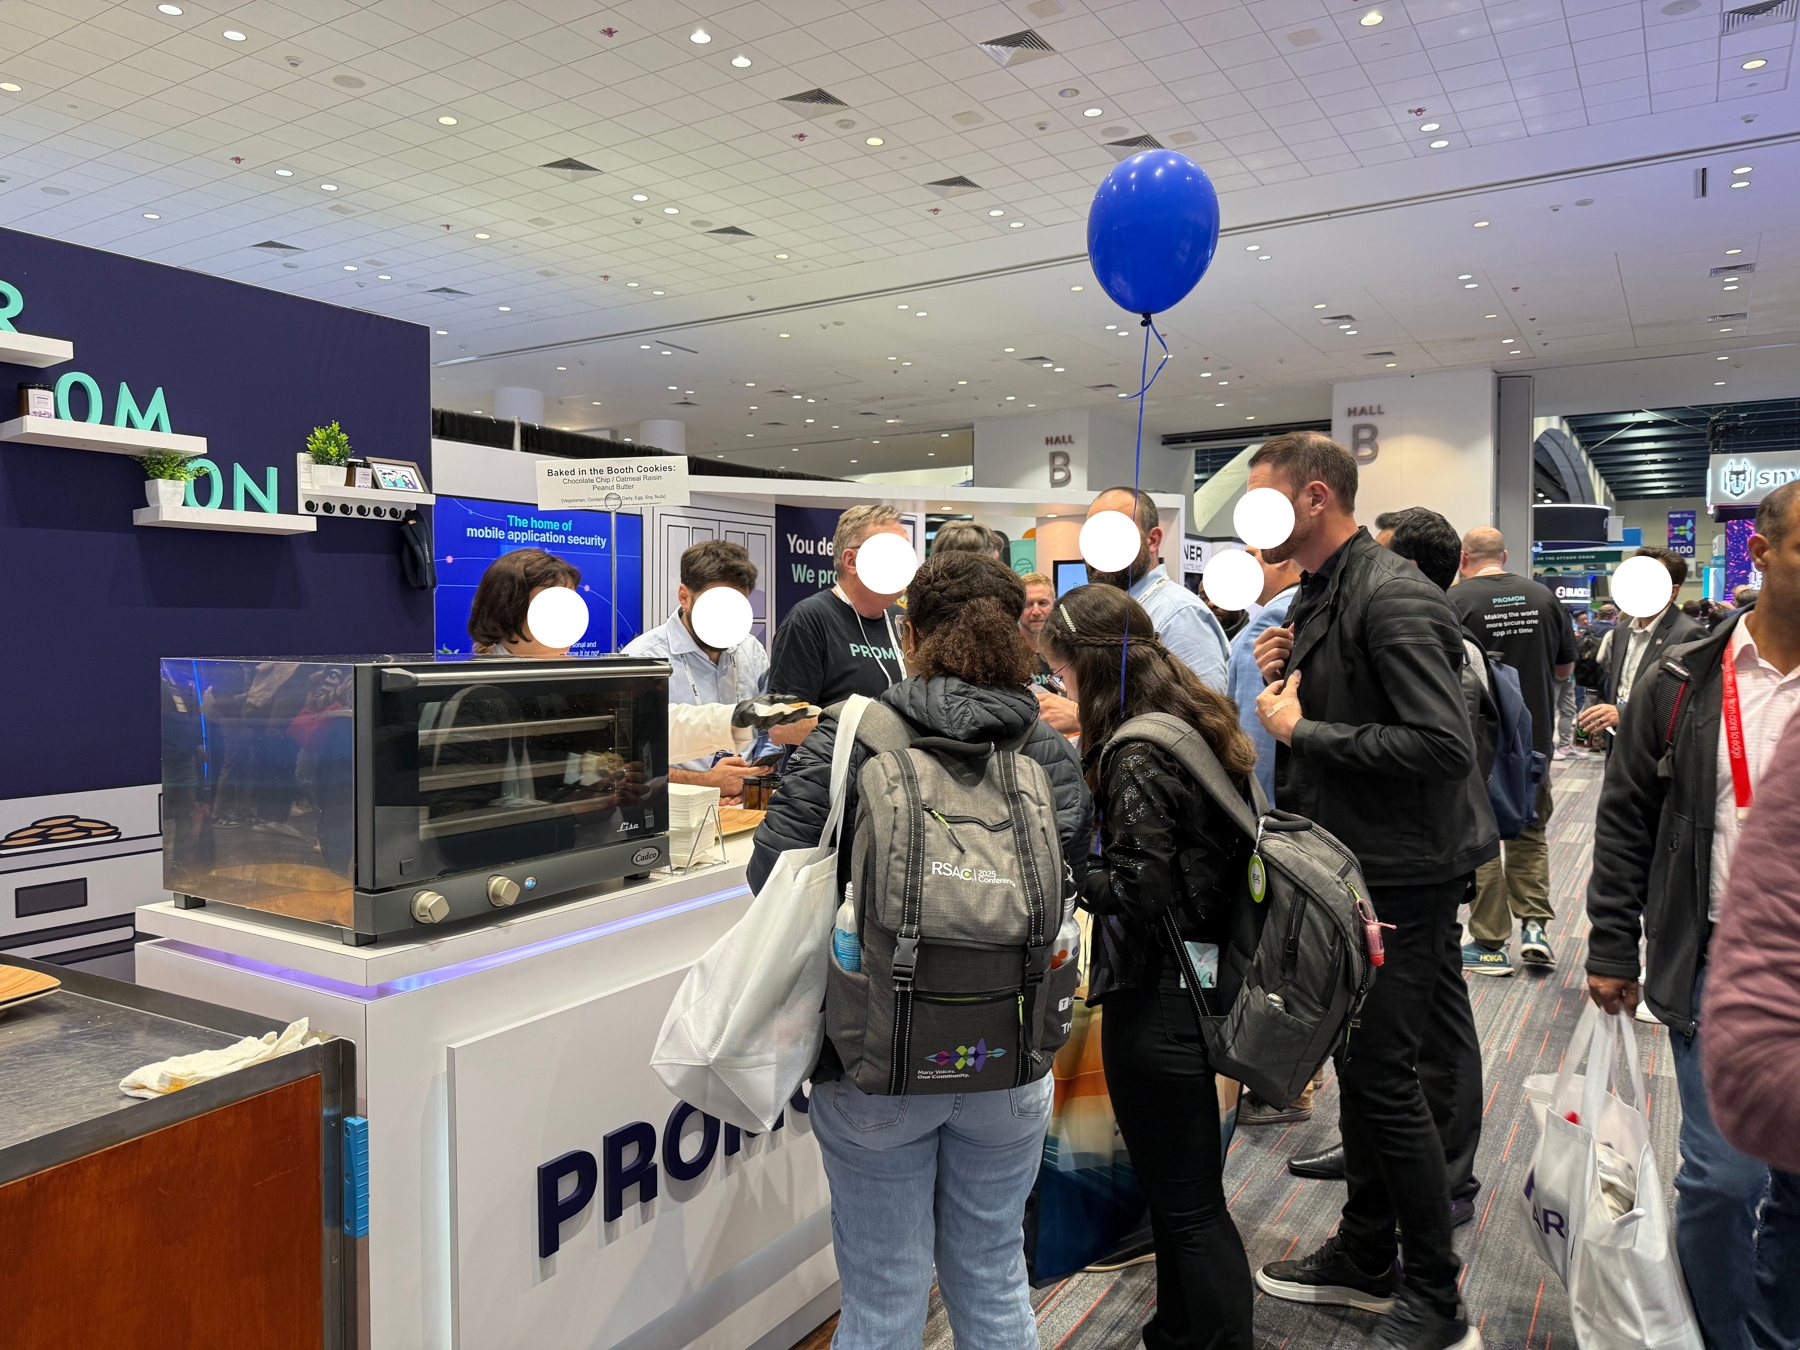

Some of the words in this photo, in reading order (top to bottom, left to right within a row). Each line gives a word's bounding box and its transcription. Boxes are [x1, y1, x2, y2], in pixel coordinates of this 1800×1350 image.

[55, 371, 172, 433] OM
[1347, 404, 1385, 417] HALL
[1045, 434, 1075, 446] HALL
[1352, 423, 1379, 466] B
[547, 467, 575, 477] Baked
[578, 467, 587, 476] in
[589, 466, 604, 475] the
[607, 465, 634, 475] Booth
[636, 464, 676, 473] Cookies:
[1049, 450, 1072, 488] B
[184, 458, 278, 514] ON
[562, 477, 594, 485] Chocolate
[596, 476, 611, 484] Chip
[507, 515, 528, 528] The
[531, 517, 560, 530] home
[562, 519, 573, 531] of
[466, 526, 505, 539] mobile
[507, 530, 566, 544] application
[567, 535, 607, 549] security
[786, 533, 814, 555] You
[817, 537, 835, 557] de
[791, 563, 815, 584] We
[818, 569, 838, 589] pro
[1492, 595, 1525, 604] PROMON
[1484, 612, 1508, 620] Making
[849, 643, 904, 660] PROM
[616, 822, 640, 833] Lisa
[635, 852, 657, 863] Cadco
[978, 869, 997, 878] 2025
[1480, 954, 1503, 962] HOKA
[537, 1081, 809, 1259] PRO
